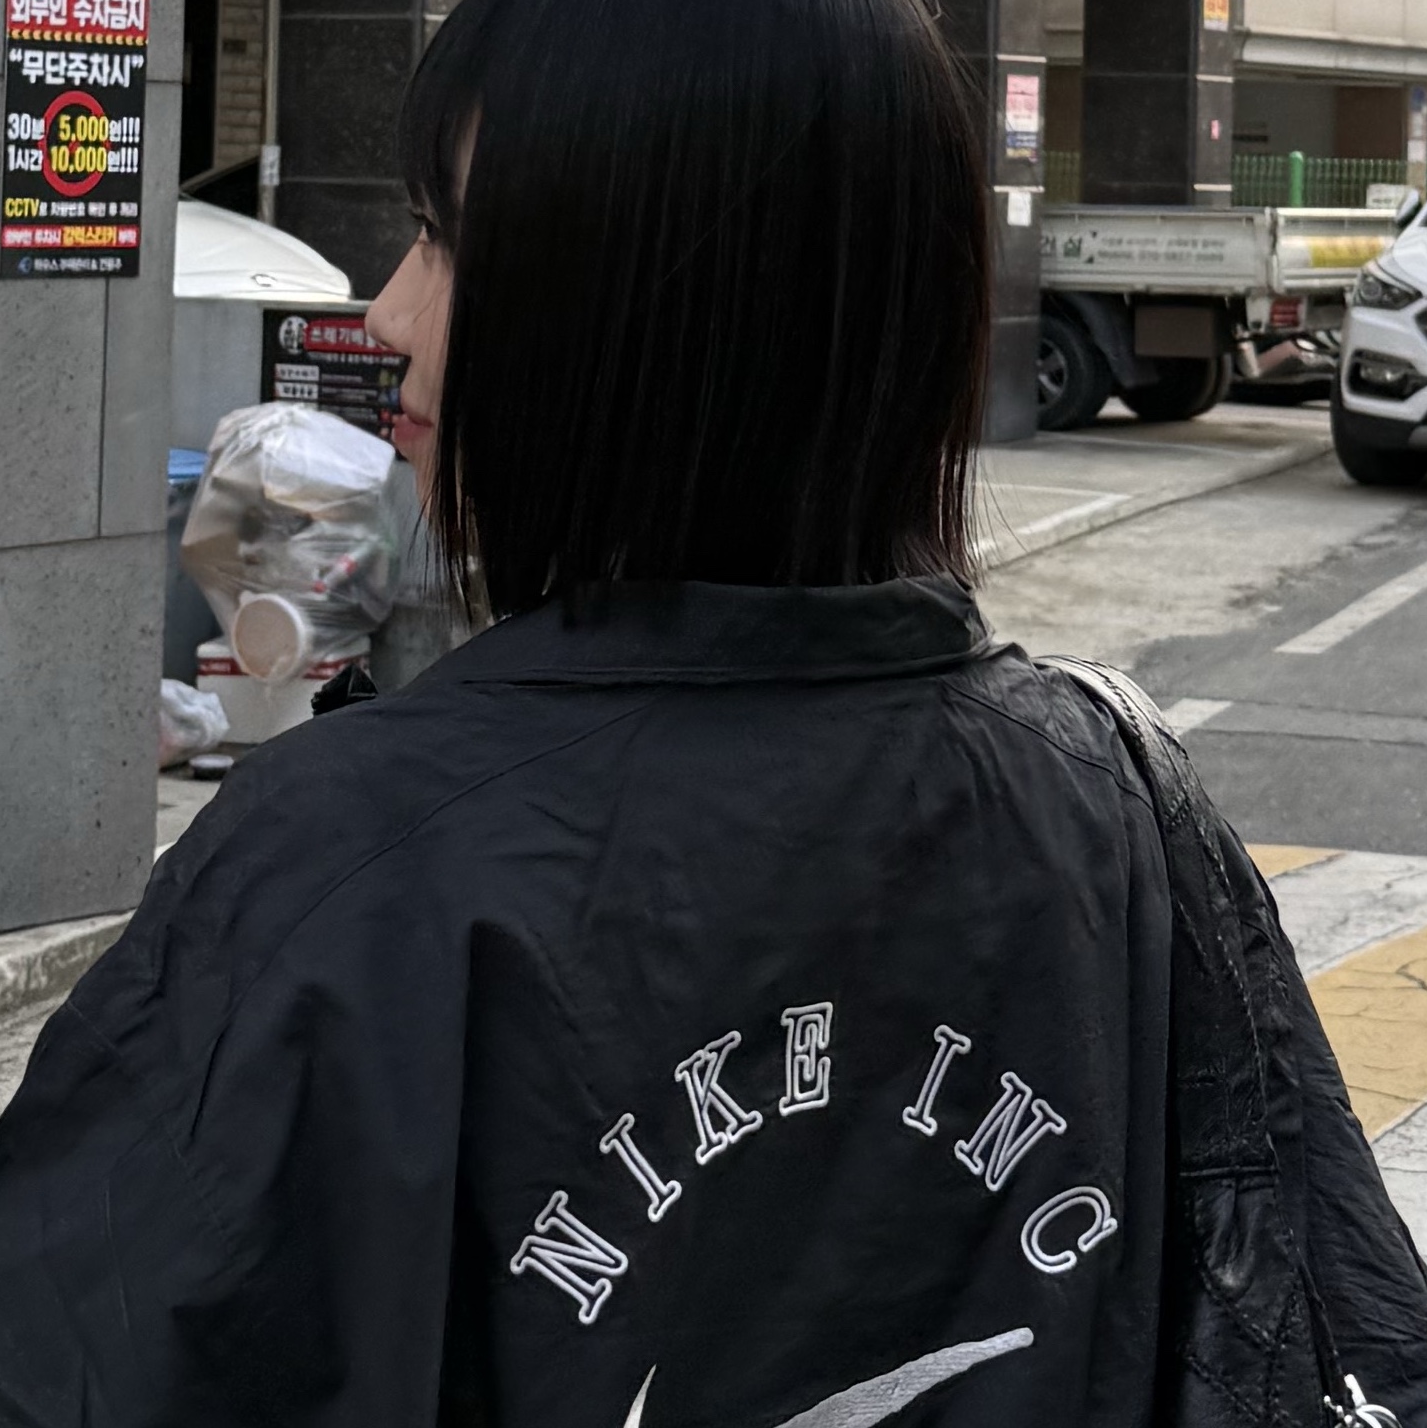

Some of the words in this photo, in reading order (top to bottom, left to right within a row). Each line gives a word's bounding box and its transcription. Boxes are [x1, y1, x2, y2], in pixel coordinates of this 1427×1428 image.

[7, 144, 44, 171] 1시간
[510, 1001, 833, 1324] NIKE
[903, 1025, 1118, 1273] INC
